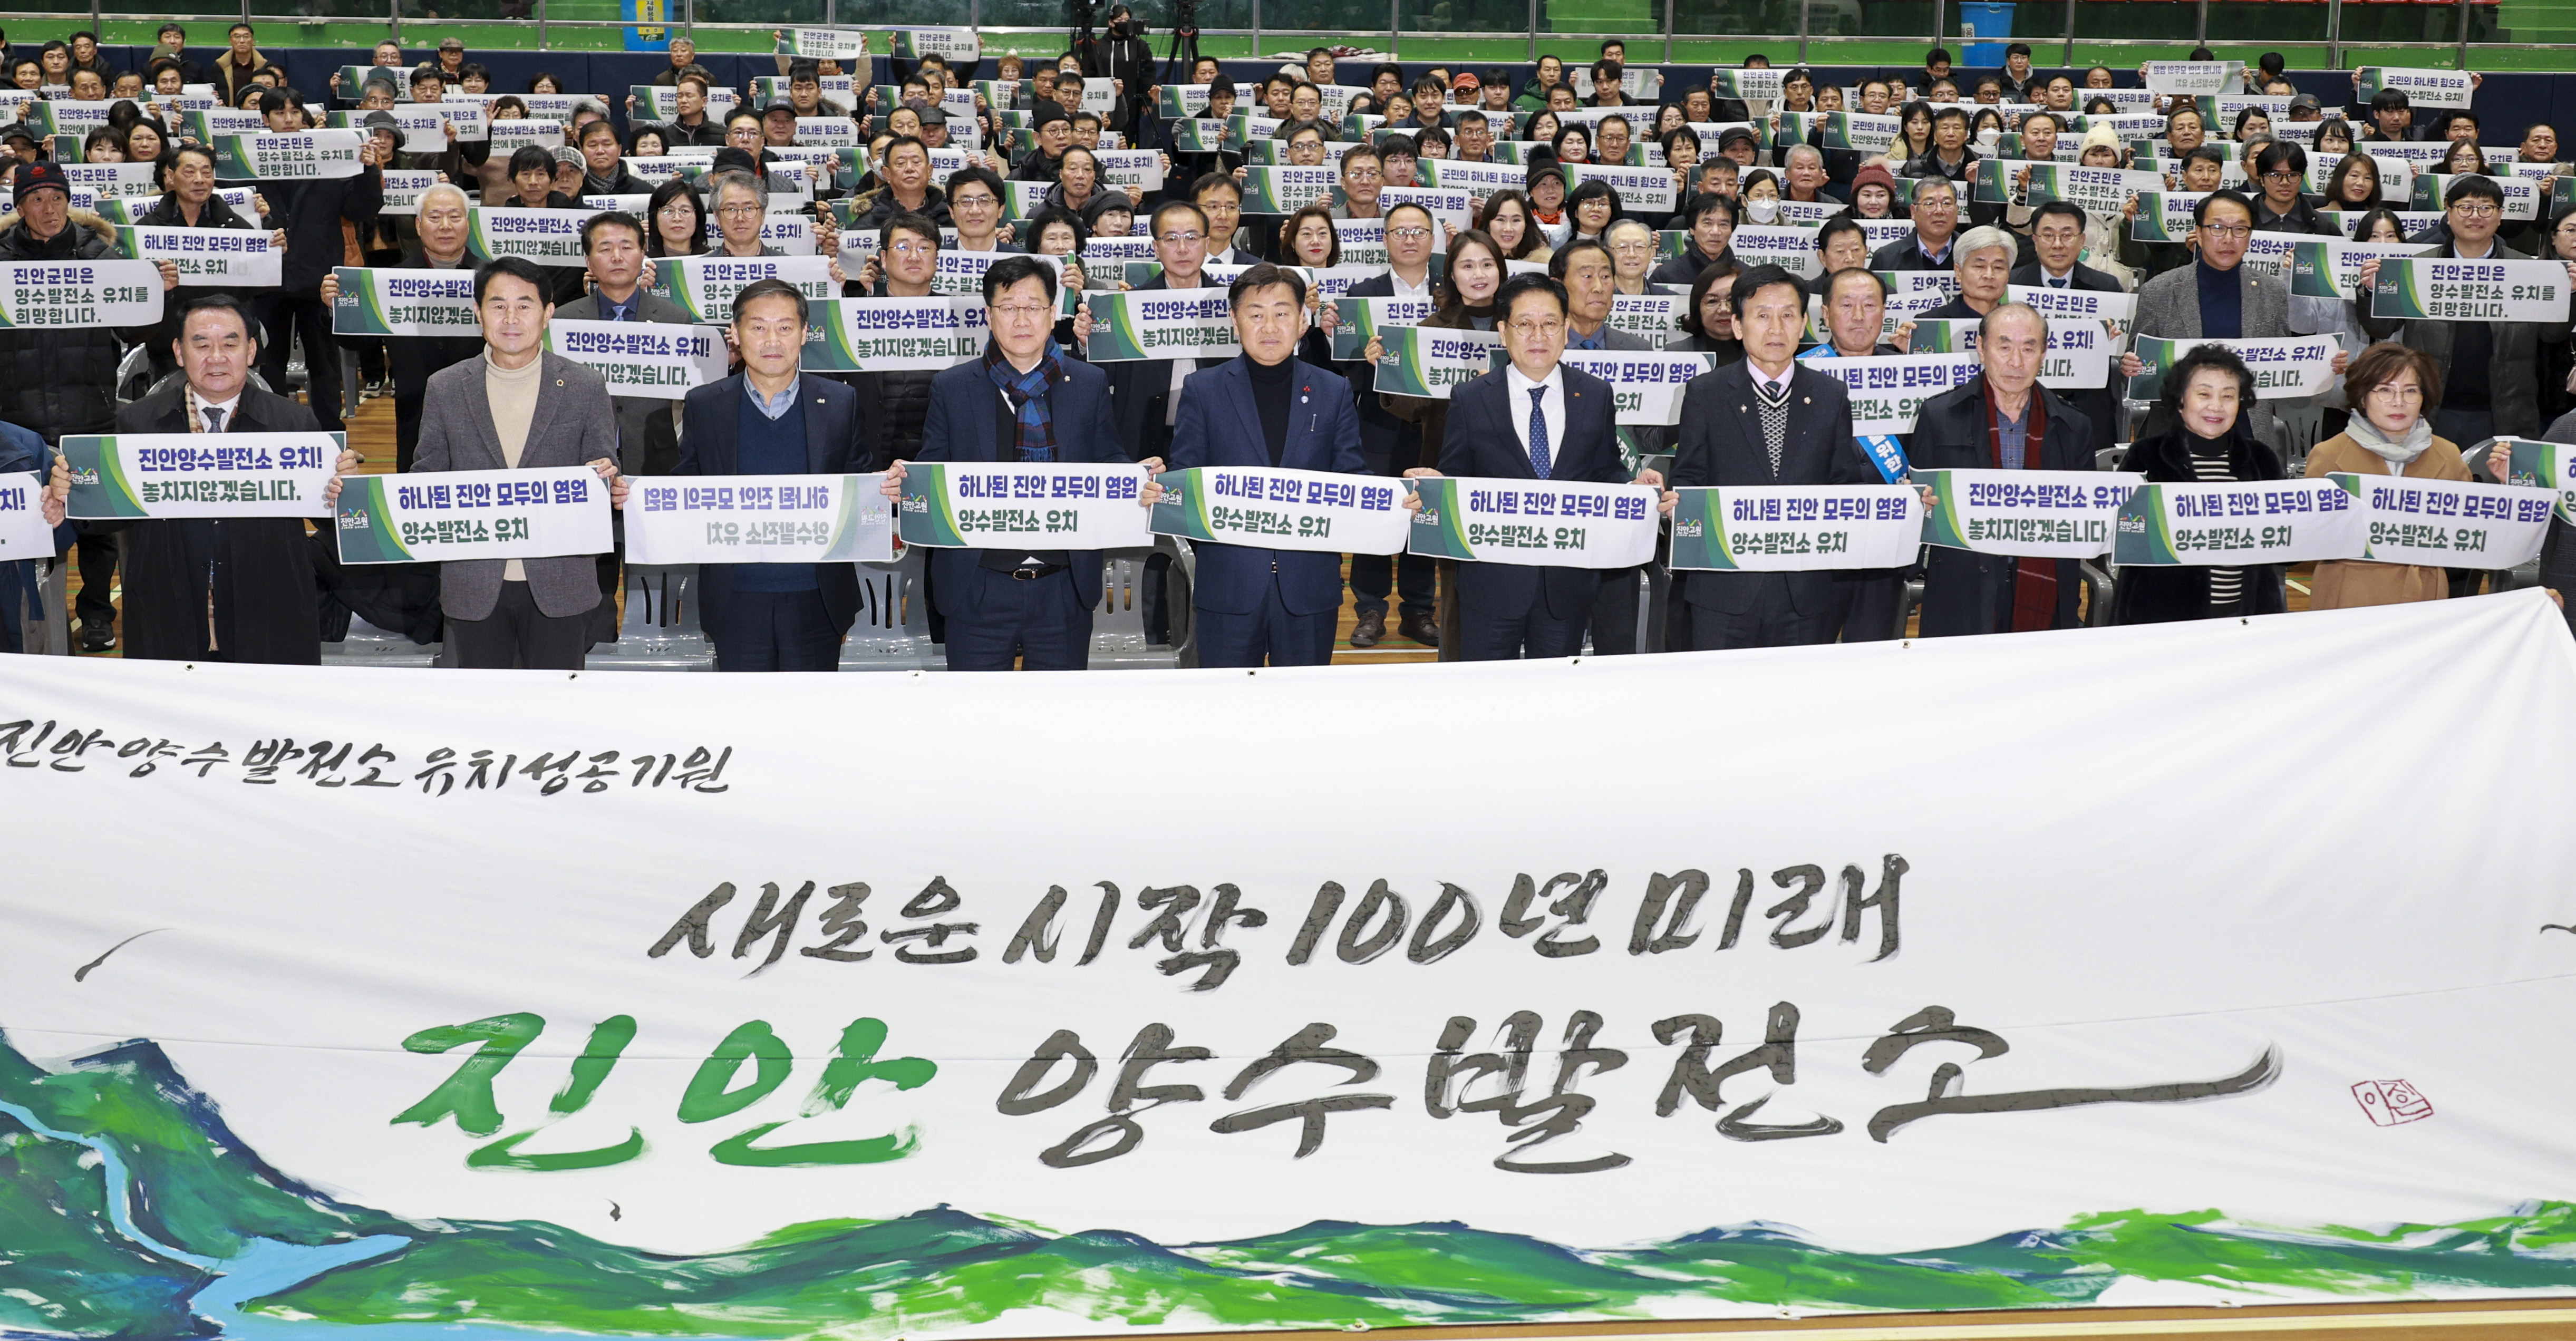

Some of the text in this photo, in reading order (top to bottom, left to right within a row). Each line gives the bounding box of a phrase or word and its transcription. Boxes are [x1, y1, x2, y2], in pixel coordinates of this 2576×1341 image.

[2388, 75, 2464, 88] 군민의 하나된 힘으로
[2445, 92, 2463, 102] 유치!
[413, 118, 437, 129] 유치로
[825, 125, 848, 134] 힘으로
[1852, 121, 1899, 133] 군민의 하나된
[256, 138, 313, 150] 진안군민은
[257, 149, 354, 162] 양수발전소 유치를
[1134, 156, 1153, 168] 유치!
[259, 163, 321, 176] 희망합니다.
[1283, 171, 1335, 183] 진안군민은
[1442, 169, 1527, 184] 군민의 하나된 힘으로
[2069, 170, 2121, 184] 진안군민은
[1611, 175, 1667, 189] 하나된 힘으로
[1645, 192, 1667, 204] 유치!
[2068, 184, 2119, 198] 양수발전소
[1446, 196, 1465, 210] 염원
[2508, 202, 2529, 212] 유치!
[491, 217, 572, 233] 진안양수발전소
[776, 224, 801, 238] 유치!
[144, 234, 267, 252] 하나된 진안 모두의 염원
[1737, 235, 1808, 251] 진안양수발전소
[205, 258, 227, 275] 유치
[703, 264, 777, 280] 진안군민은
[2432, 265, 2505, 281] 진안군민은
[13, 268, 93, 285] 진안군민은
[15, 287, 148, 305] 양수발전소 유치를
[2430, 284, 2555, 300] 양수발전소 유치를
[1907, 297, 1942, 310] 유치로
[2027, 293, 2097, 313] 진안군민은
[2429, 302, 2507, 317] 희망합니다.
[16, 307, 101, 325] 희망합니다.
[857, 309, 960, 329] 진안양수발전소
[566, 332, 710, 357] 진안양수발전소 유치!
[858, 338, 981, 357] 놓치지않겠습니다.
[2062, 331, 2093, 349] 유치!
[2291, 346, 2325, 361] 유치!
[1590, 363, 1697, 383] 진안 모두의 염원
[1868, 368, 1898, 388] 진안
[1903, 367, 1947, 387] 모두의
[139, 447, 322, 471] 진안양수발전소 유치!
[142, 481, 301, 502] 놓치지않겠습니다.
[399, 480, 588, 509] 하나된 진안 모두의 염원
[960, 475, 1137, 499] 하나된 진안 모두의 염원
[1215, 473, 1393, 511] 하나된 진안 모두의 염원
[1970, 483, 2087, 507] 진안양수발전소
[902, 501, 927, 511] 진안고원
[1470, 490, 1647, 520] 하나된 진안 모두의 염원
[1734, 498, 1907, 521] 하나된 진안 모두의 염원
[2176, 489, 2348, 517] 하나된 진안 모두의 염원
[2373, 488, 2550, 522] 하나된 진안 모두의 염원
[341, 517, 368, 526] 진안고원
[959, 510, 1077, 532] 양수발전소 유치
[1212, 506, 1331, 538] 양수발전소 유치
[402, 517, 528, 545] 양수발전소 유치
[1469, 523, 1585, 550] 양수발전소 유치
[1677, 526, 1702, 535] 진안고원
[2176, 526, 2291, 550] 양수발전소 유치
[2370, 522, 2486, 552] 양수발전소 유치
[1732, 532, 1847, 555] 양수발전소 유치
[647, 874, 981, 980] 새로운
[1002, 880, 1268, 993] 시작
[1627, 853, 1910, 964] 미래
[390, 1010, 937, 1172] 진안
